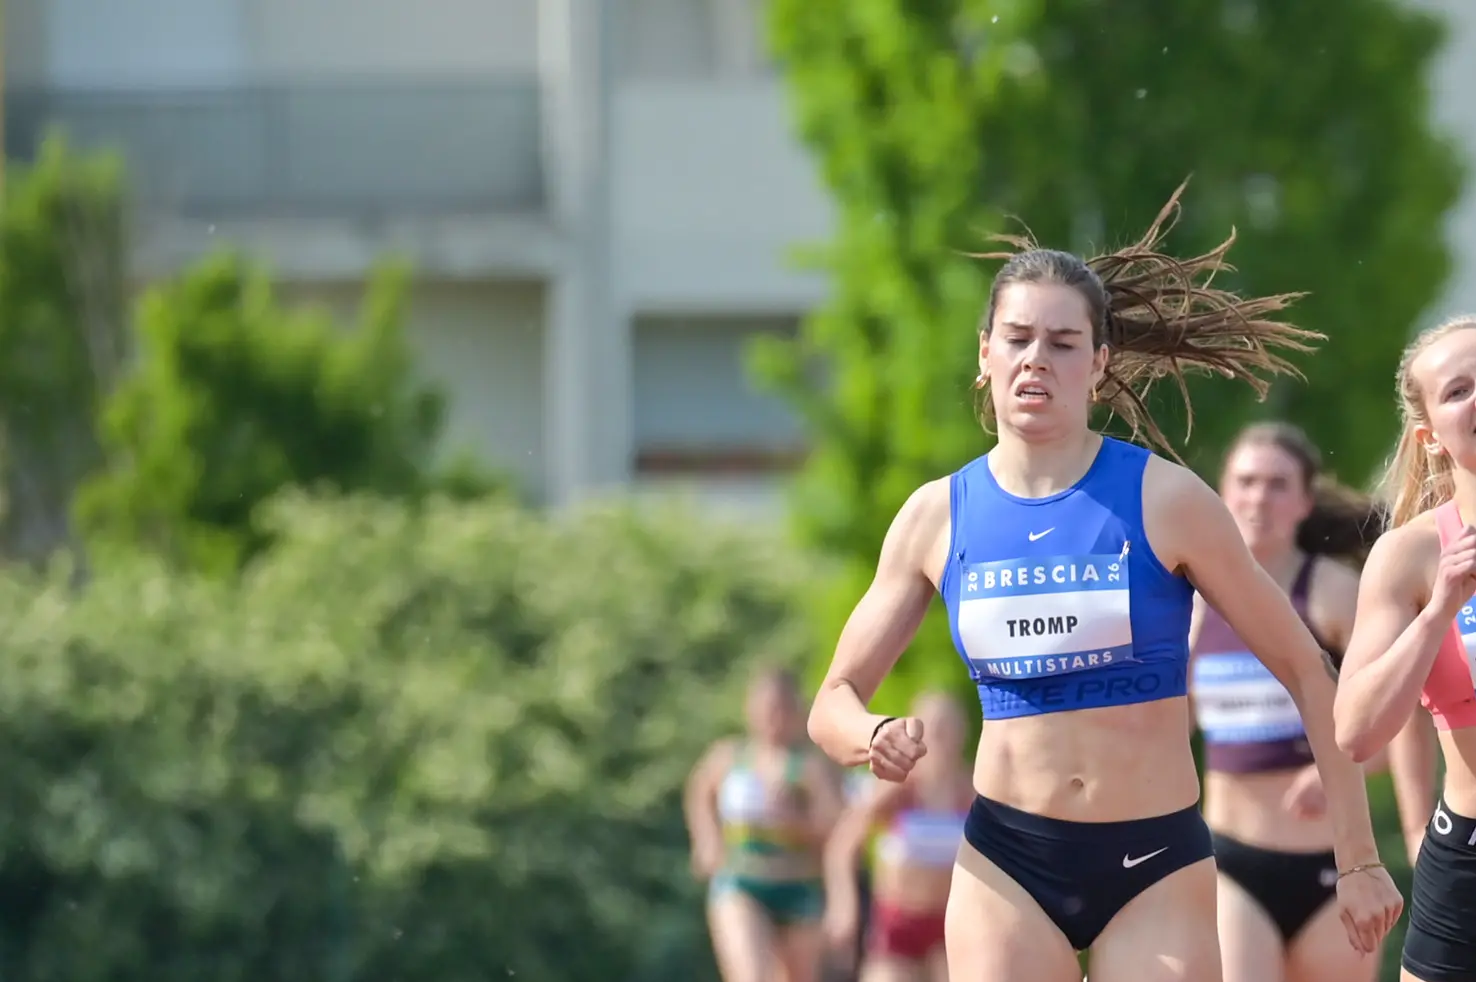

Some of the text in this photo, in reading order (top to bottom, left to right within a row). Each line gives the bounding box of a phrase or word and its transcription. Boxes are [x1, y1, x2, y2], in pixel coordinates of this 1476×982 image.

[967, 562, 1120, 592] 20 BRESCIA 26
[1006, 615, 1078, 638] TROMP
[1462, 605, 1476, 626] 20
[986, 650, 1113, 676] MULTISTARS
[1076, 672, 1161, 702] PRO
